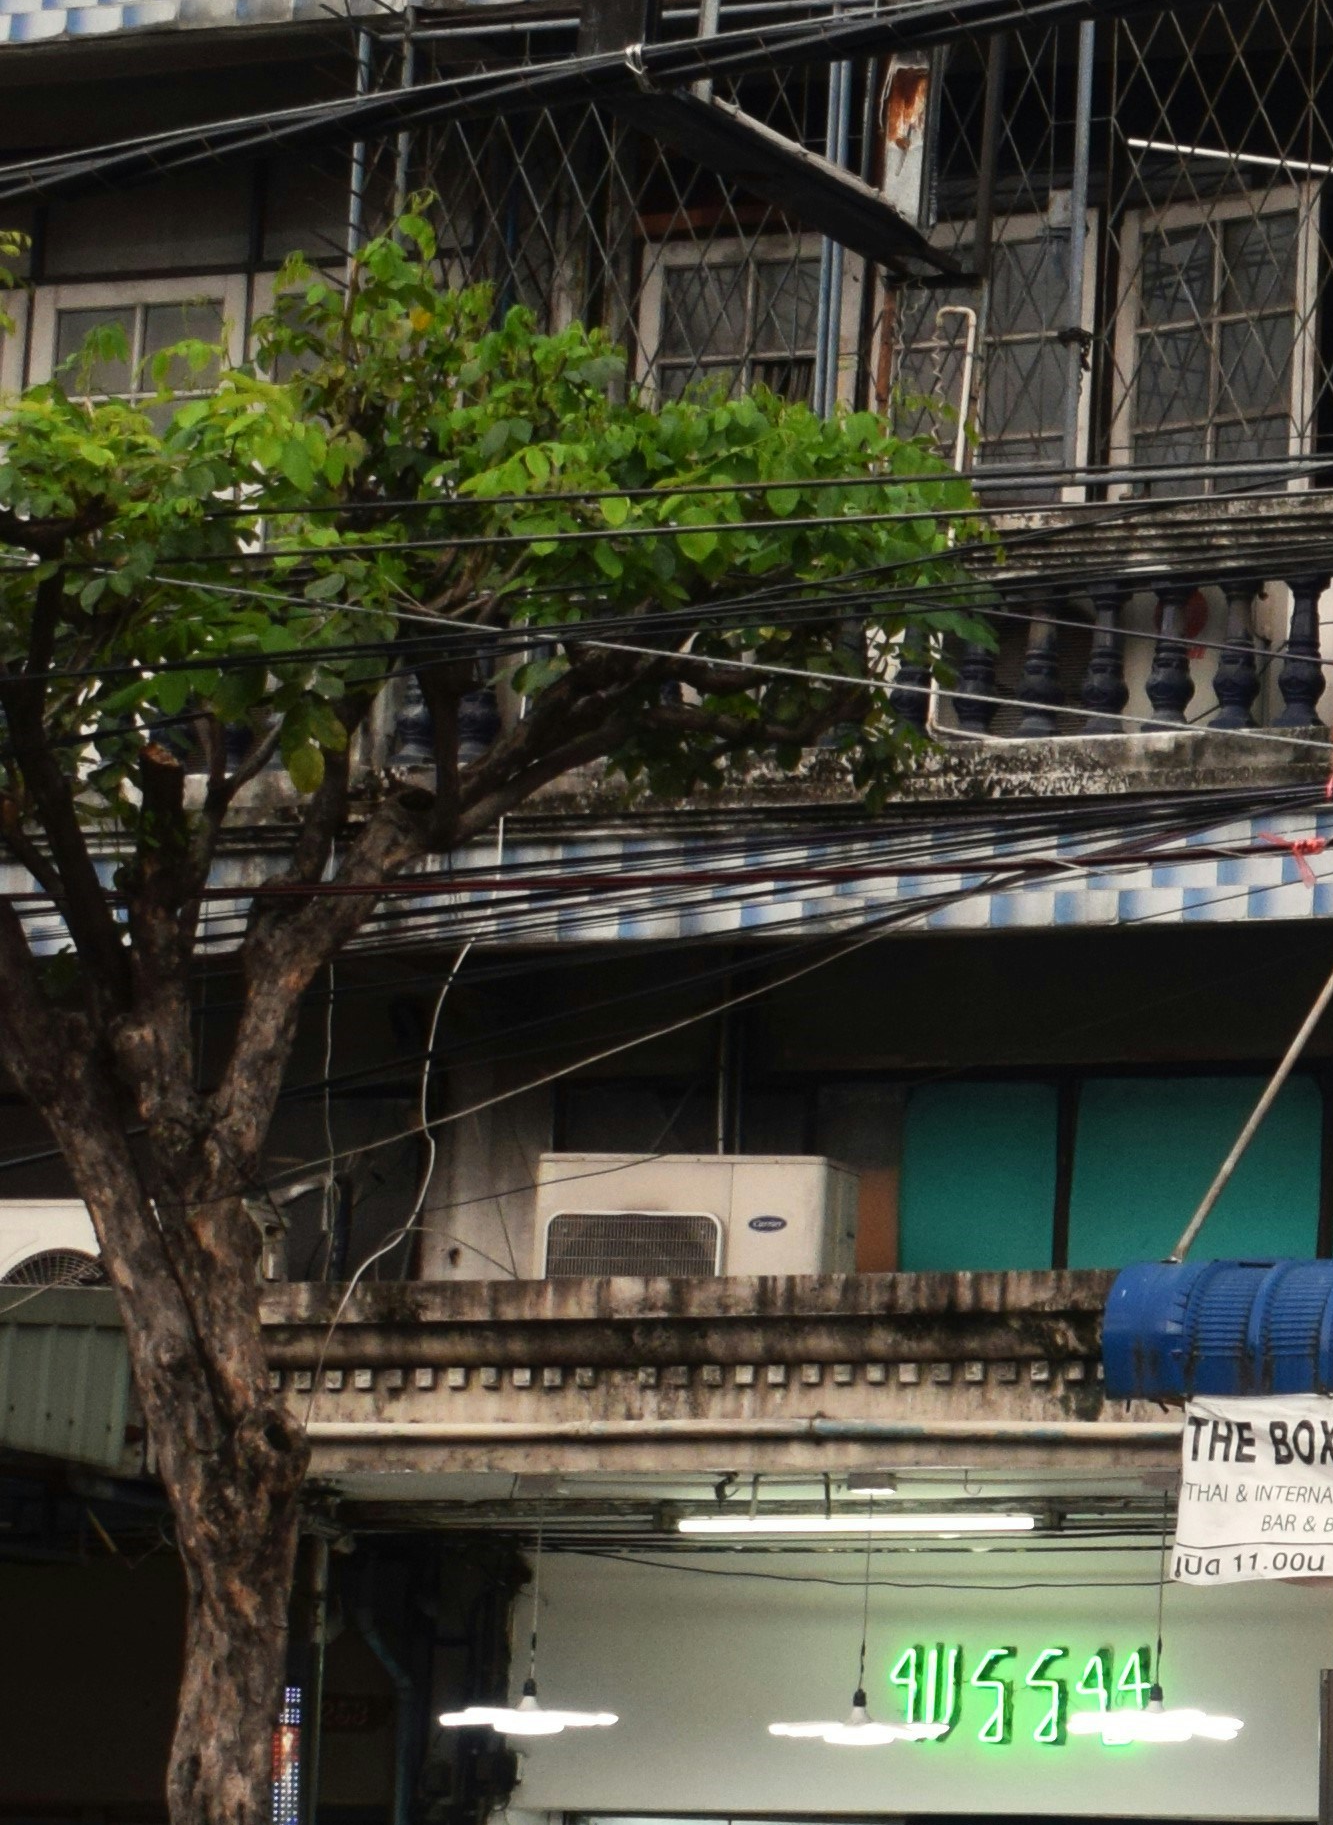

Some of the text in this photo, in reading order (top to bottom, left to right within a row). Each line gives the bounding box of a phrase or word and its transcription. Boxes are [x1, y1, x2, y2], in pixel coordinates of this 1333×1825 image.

[1188, 1416, 1256, 1463] THE
[1185, 1482, 1228, 1503] THAI
[1236, 1484, 1247, 1503] &
[1261, 1514, 1295, 1532] BAR
[1303, 1516, 1316, 1532] &
[1234, 1552, 1325, 1573] 11.00น
